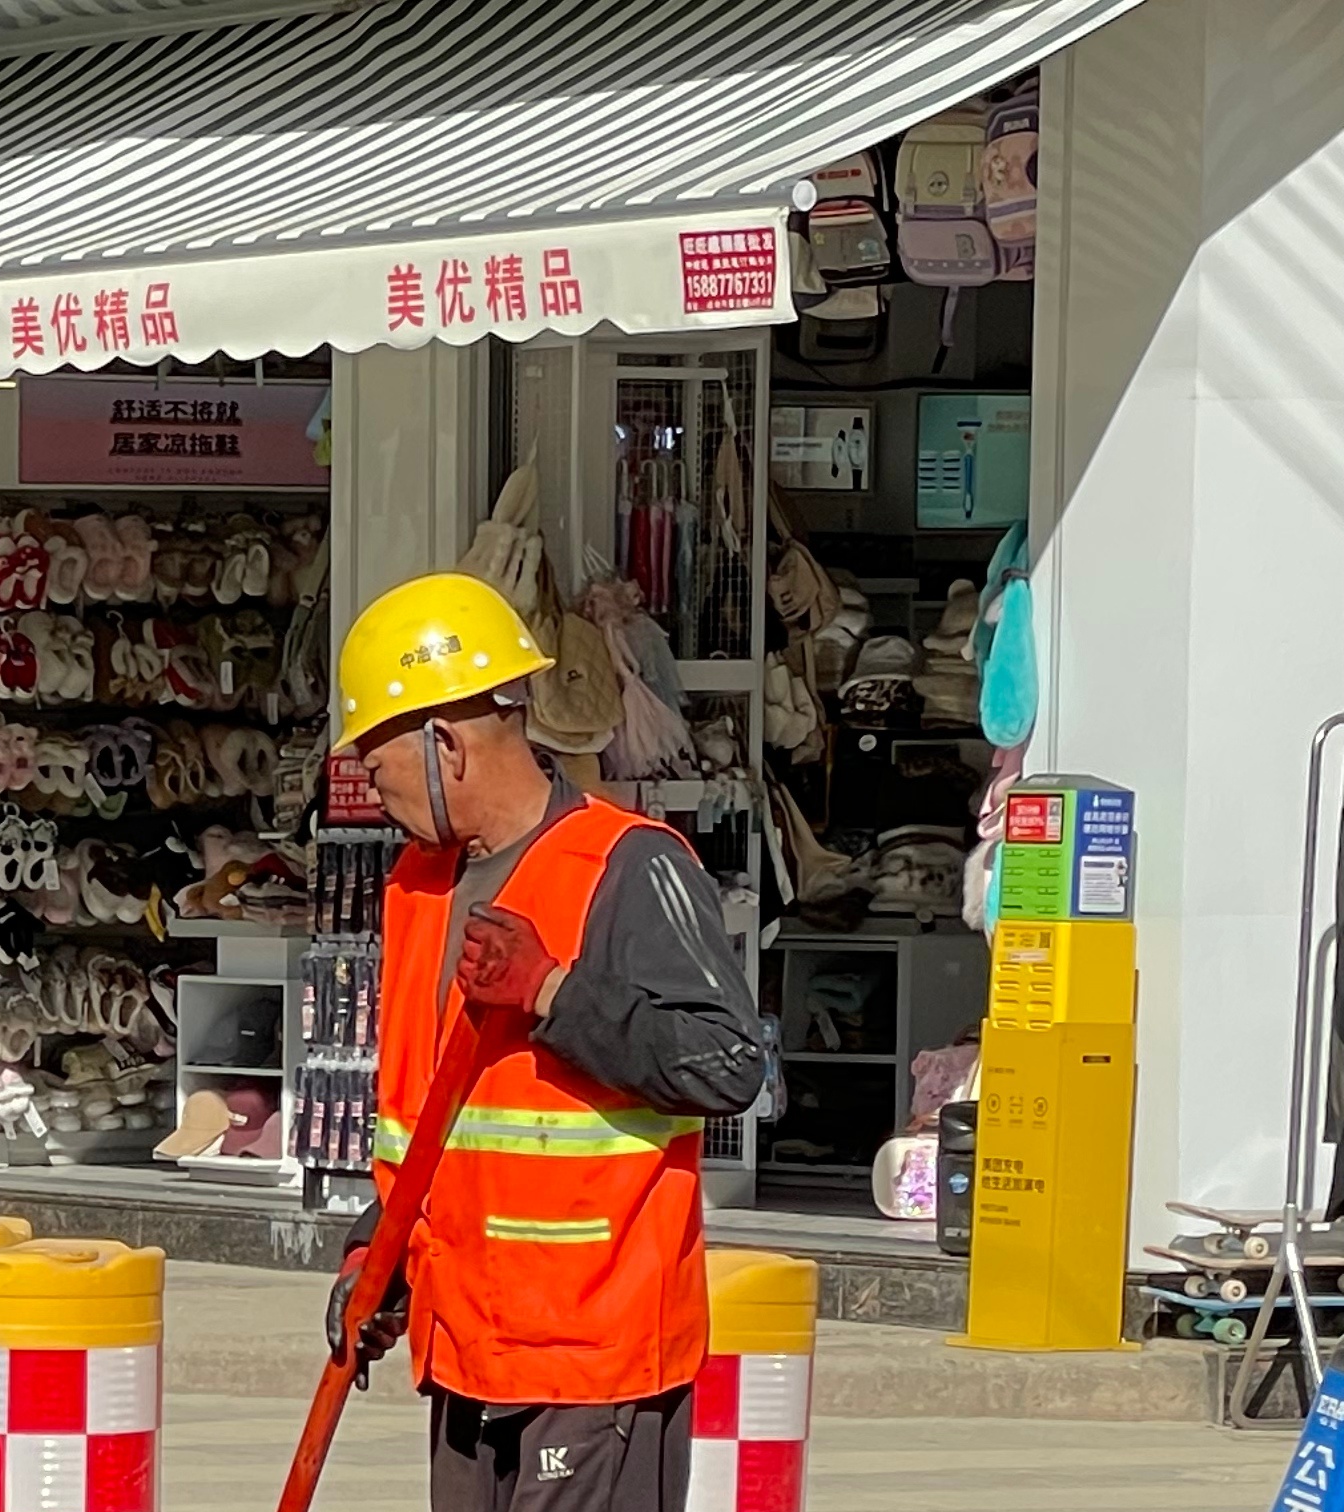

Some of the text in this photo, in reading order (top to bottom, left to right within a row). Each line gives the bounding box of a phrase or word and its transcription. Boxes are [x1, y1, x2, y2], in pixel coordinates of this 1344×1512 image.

[387, 247, 584, 333] 美优精品
[687, 271, 773, 299] 15887767331
[12, 282, 180, 360] 美优精品
[112, 399, 240, 421] 舒适不将就
[112, 432, 240, 455] 居家凉拖鞋
